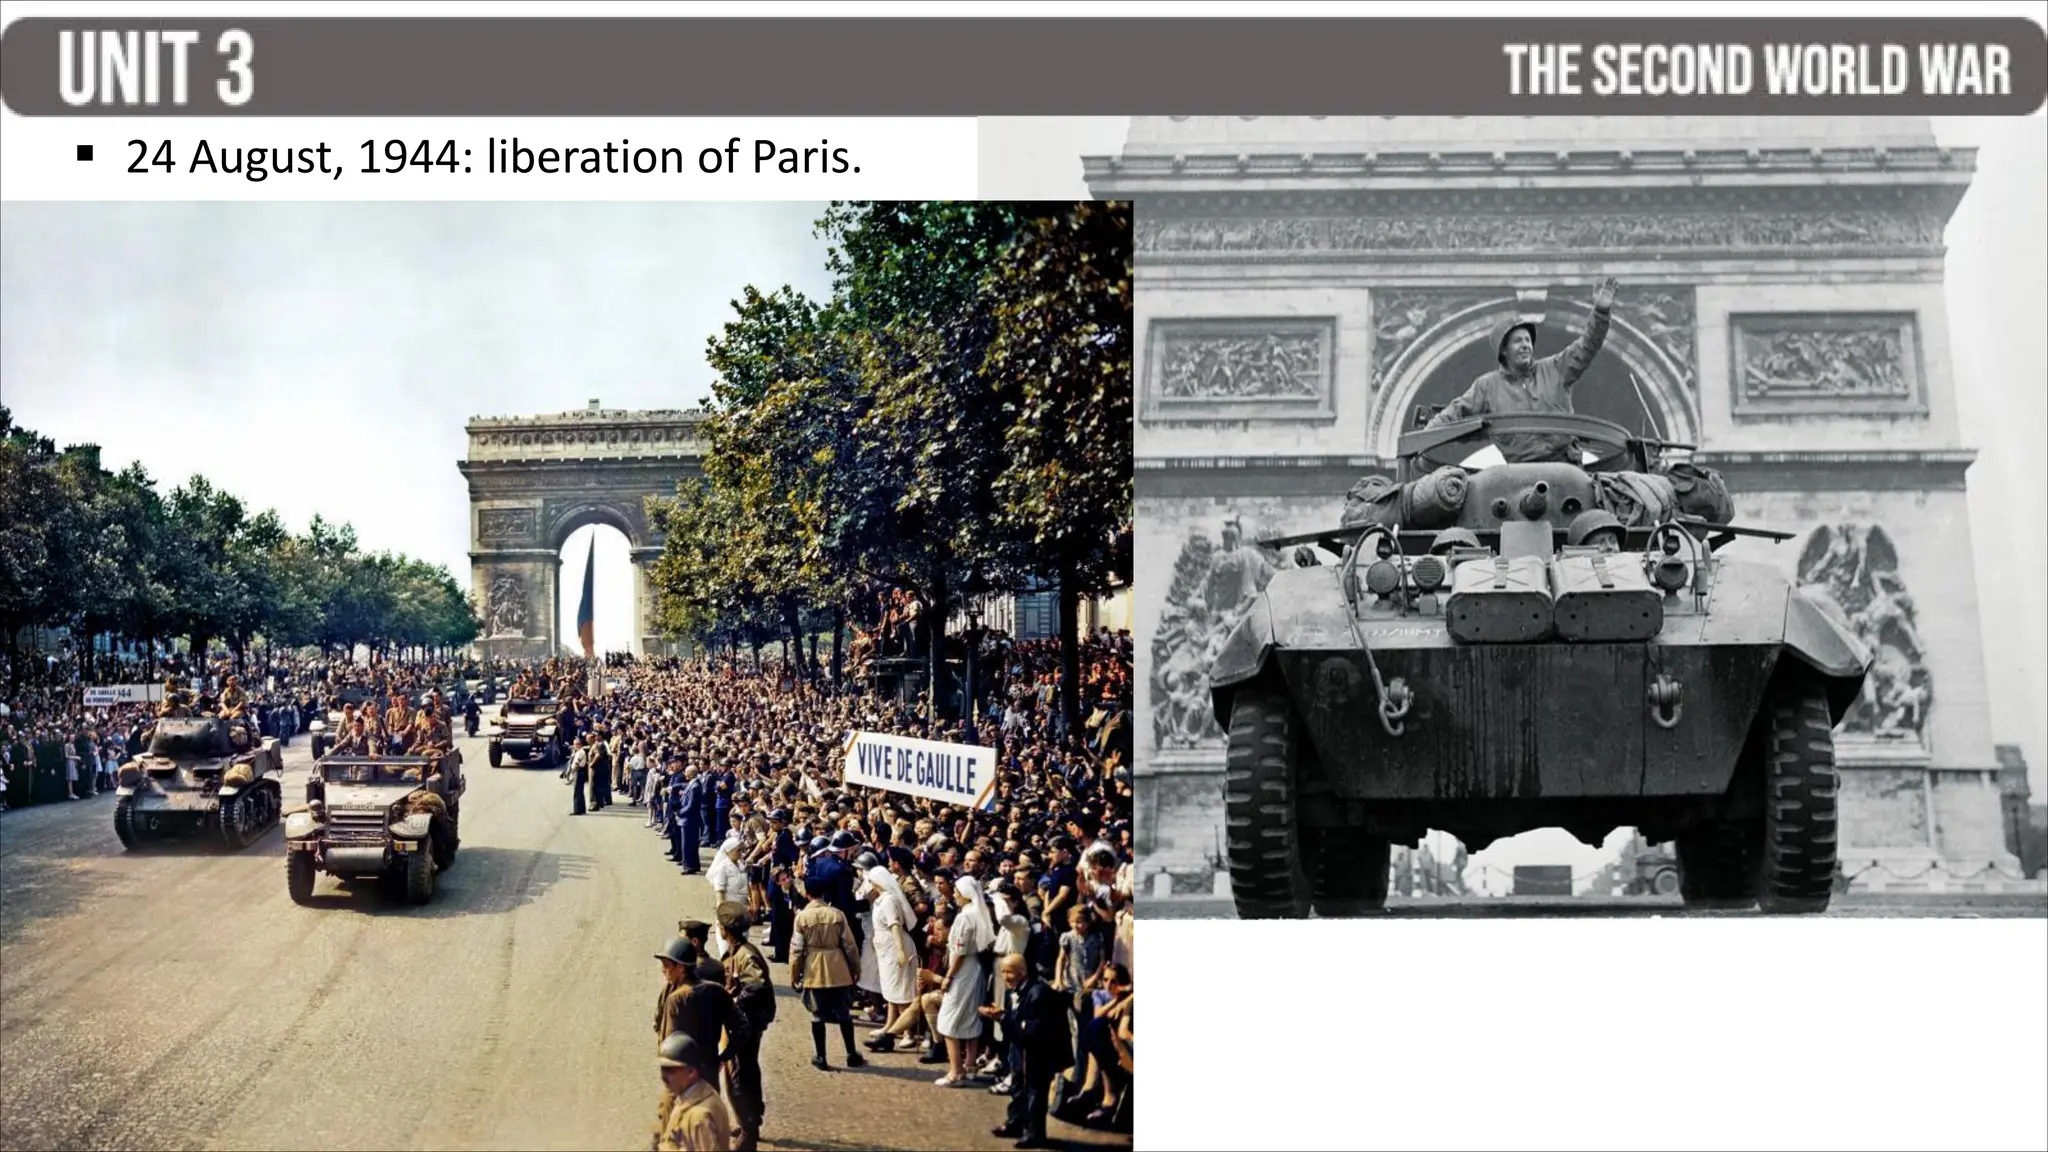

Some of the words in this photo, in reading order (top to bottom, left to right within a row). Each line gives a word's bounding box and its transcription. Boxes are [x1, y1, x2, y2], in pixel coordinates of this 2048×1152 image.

[857, 742, 893, 780] VIVE
[897, 747, 913, 784] DE
[916, 751, 977, 796] GAULLE
